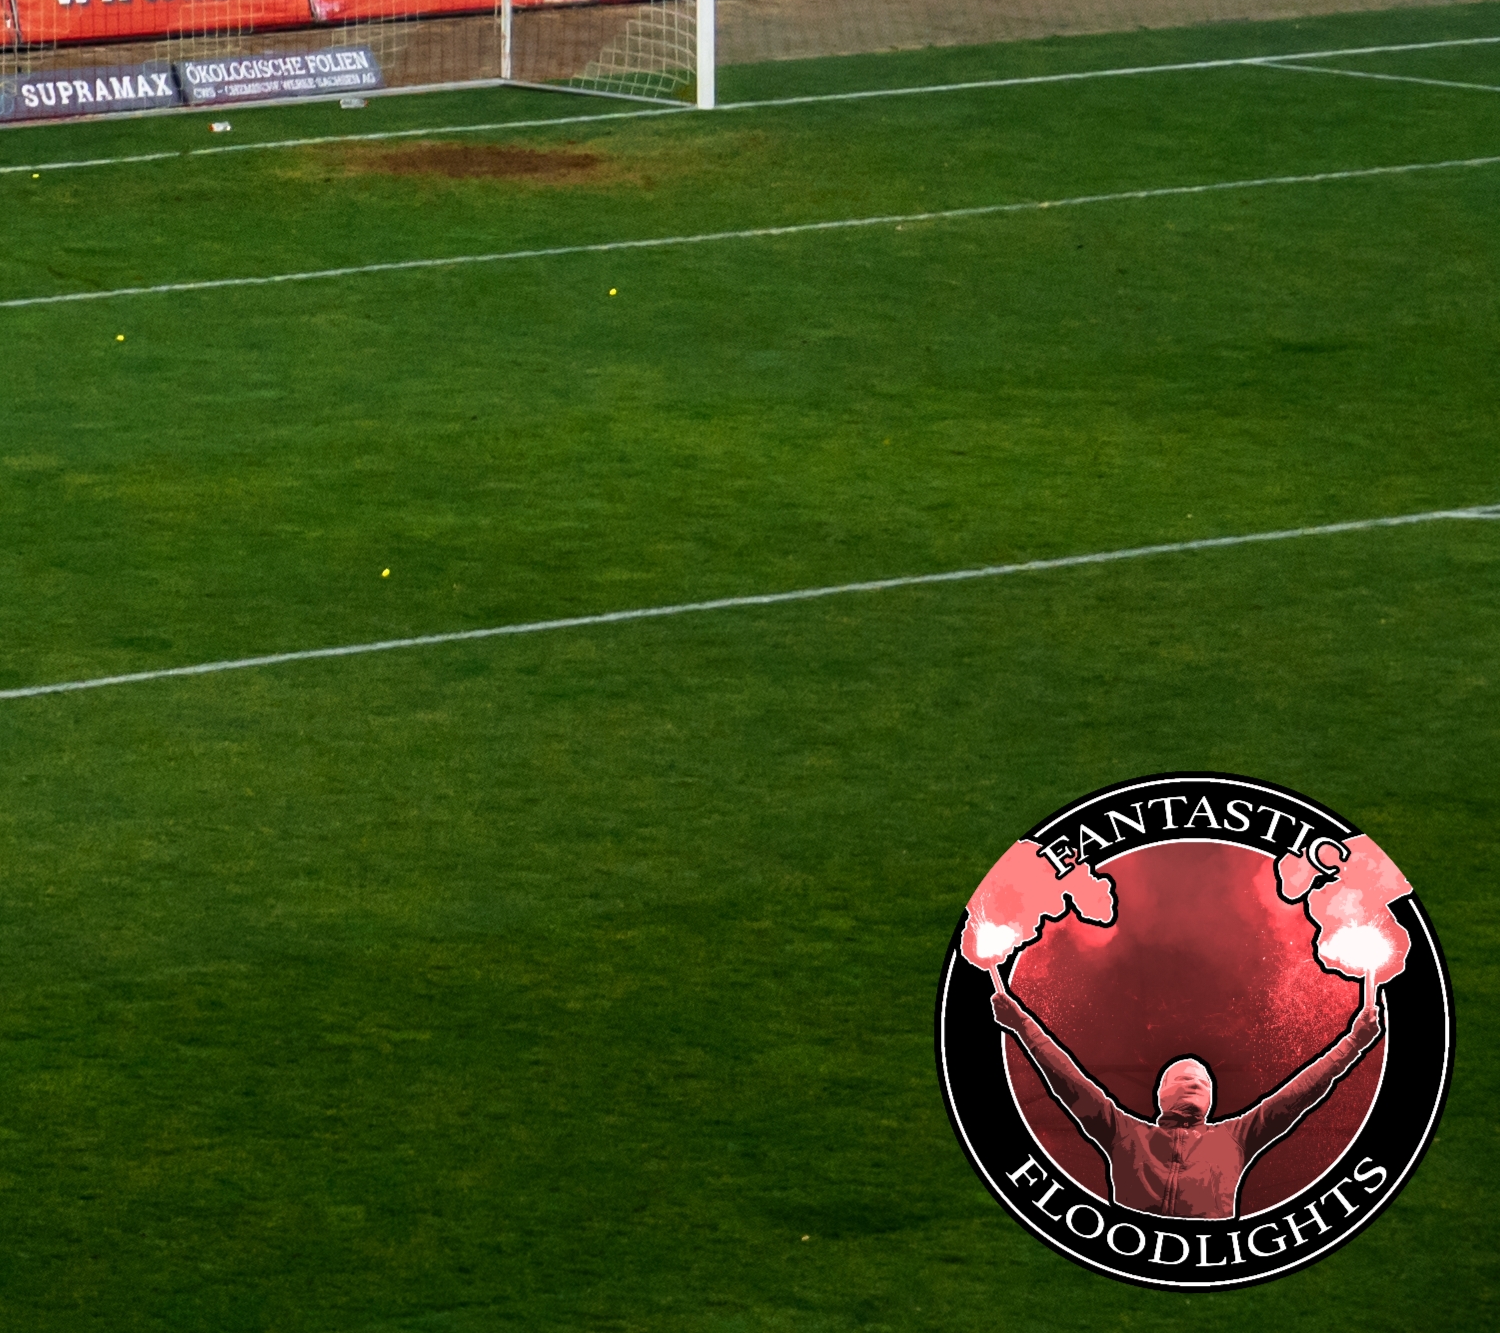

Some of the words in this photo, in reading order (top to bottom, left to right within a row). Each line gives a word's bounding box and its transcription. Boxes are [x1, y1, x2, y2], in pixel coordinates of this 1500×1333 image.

[185, 56, 305, 85] ÖKOLOGISCHE
[305, 50, 370, 74] FOLIEN
[20, 72, 174, 107] SUPRAMAX
